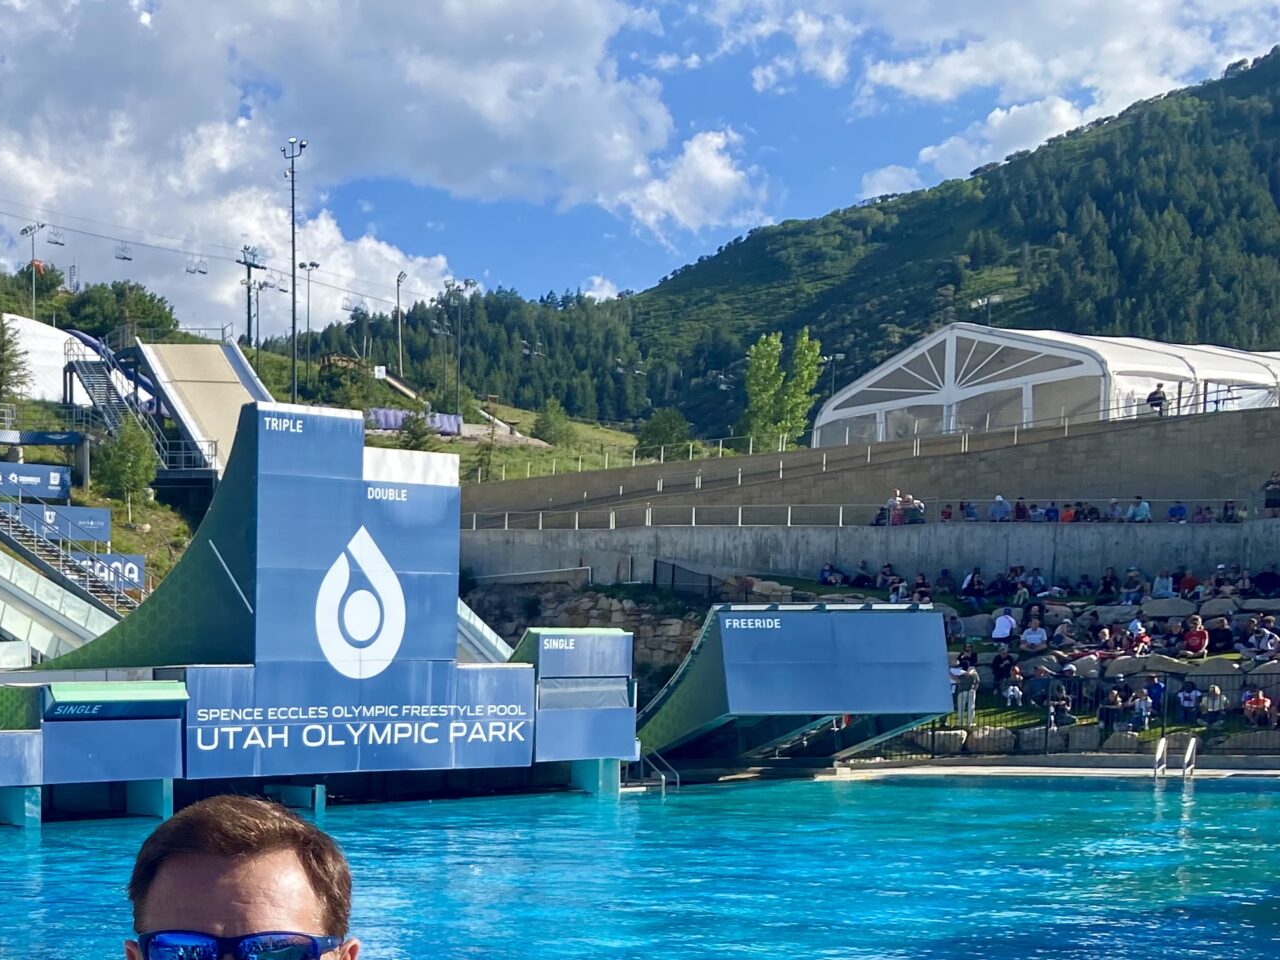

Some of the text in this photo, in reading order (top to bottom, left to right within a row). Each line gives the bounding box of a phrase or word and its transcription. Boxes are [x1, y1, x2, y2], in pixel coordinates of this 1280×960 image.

[264, 417, 303, 433] TRIPLE
[367, 487, 408, 501] DOUBLE
[725, 618, 782, 629] FREERIDE
[543, 638, 576, 650] SINGLE
[54, 704, 102, 715] SINGLE
[197, 704, 526, 721] SPENCE ECCLES OLYMPIC FREESTYLE POOL
[197, 721, 526, 750] UTAH OLYMPIC PARK
